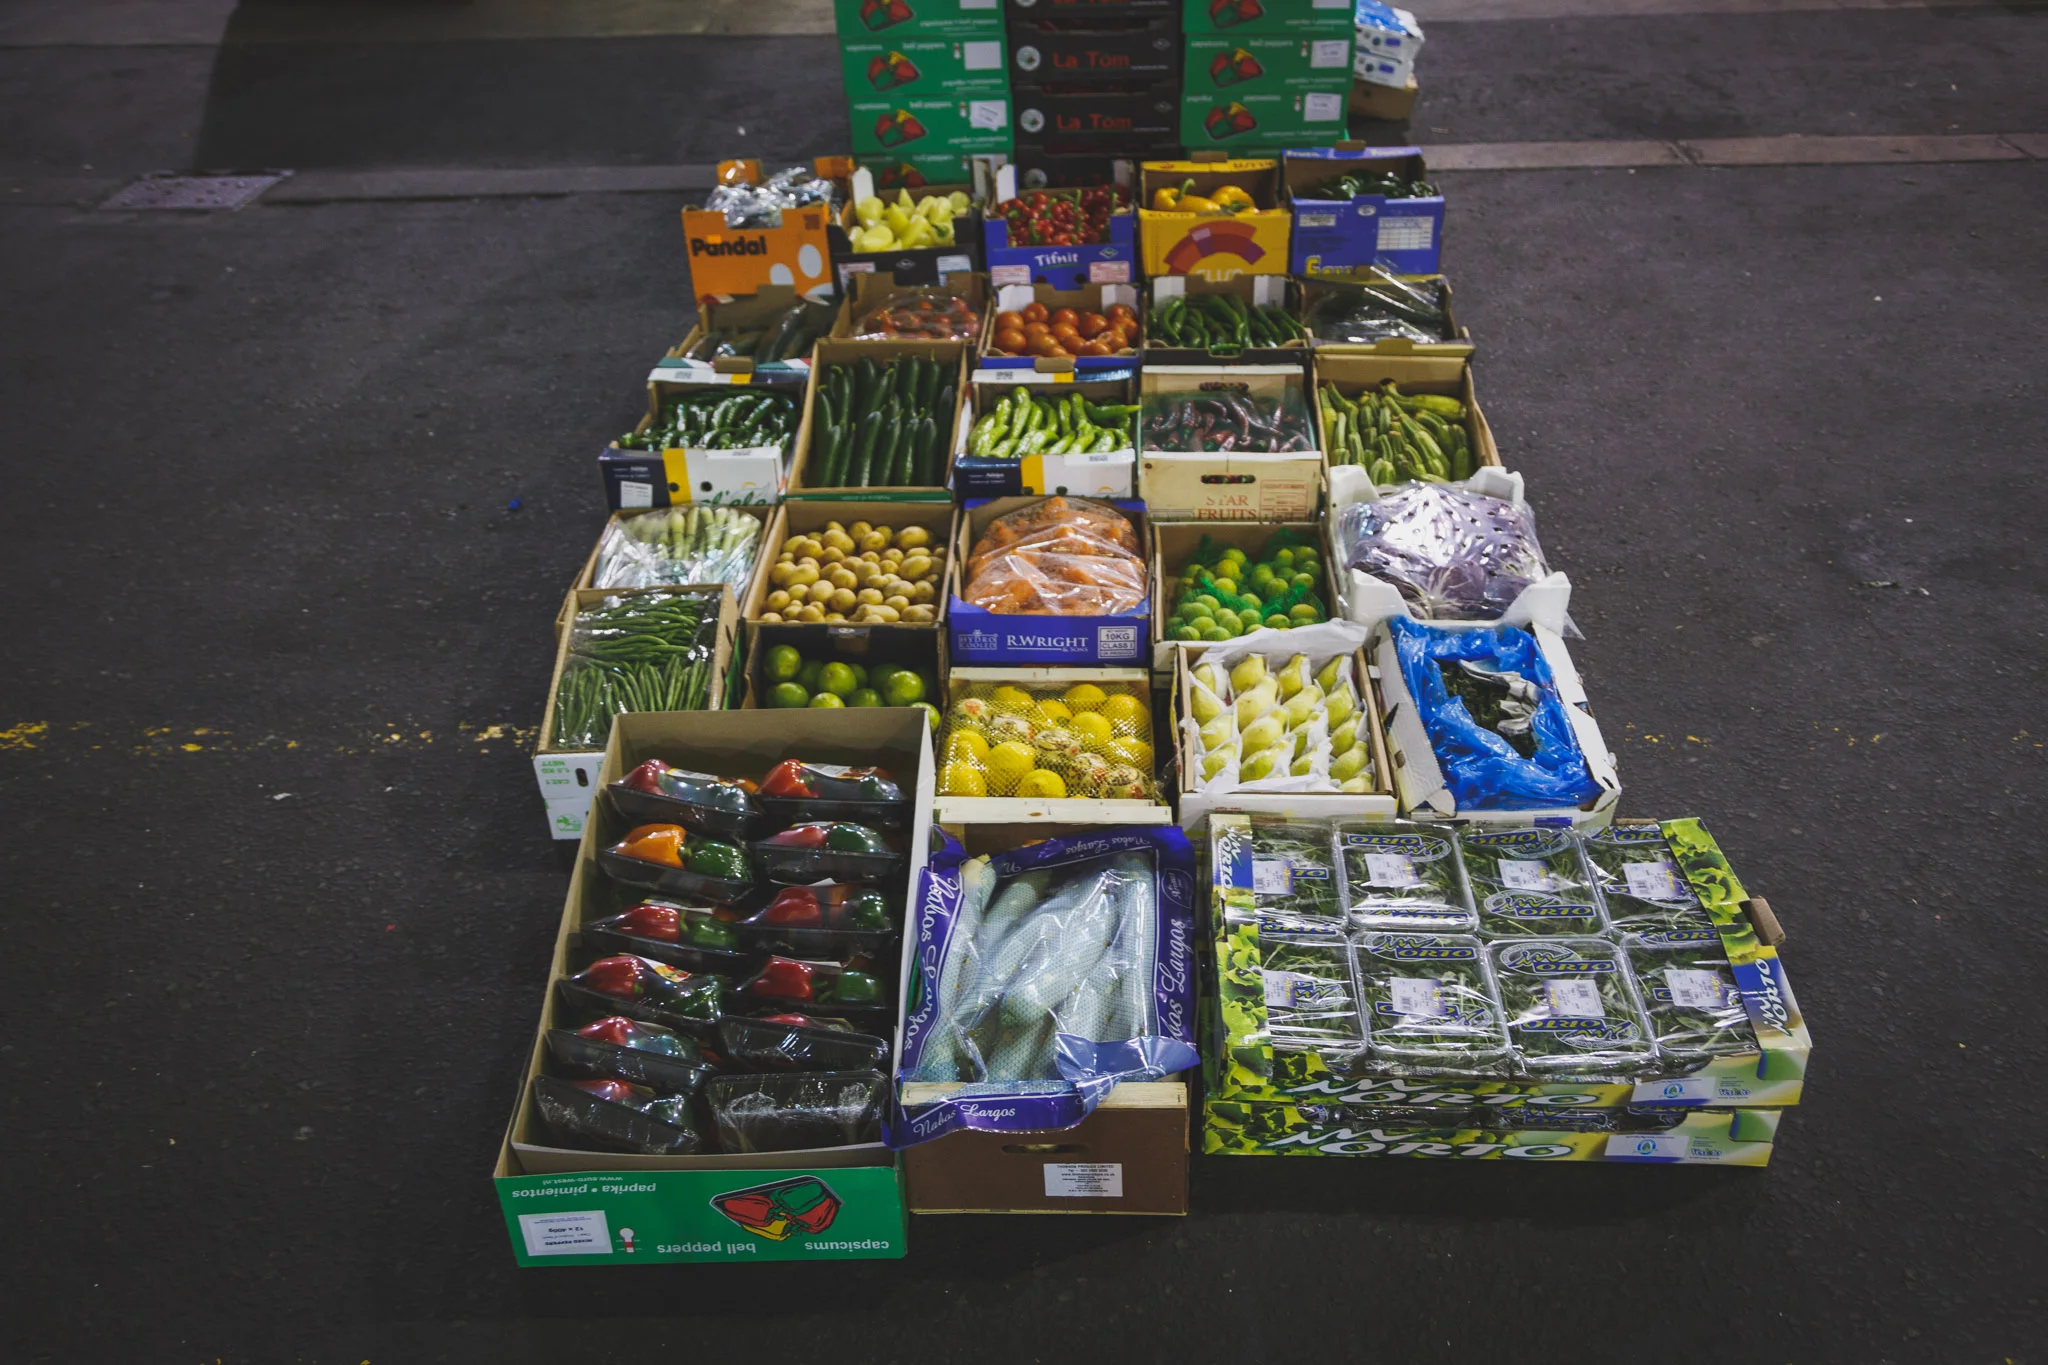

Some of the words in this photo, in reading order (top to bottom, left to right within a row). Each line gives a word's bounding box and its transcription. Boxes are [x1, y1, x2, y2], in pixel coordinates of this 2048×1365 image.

[1053, 52, 1078, 68] La
[1086, 51, 1130, 68] Tom
[1056, 114, 1081, 130] La
[1089, 113, 1131, 129] Tom
[691, 235, 767, 256] Pandal
[1197, 508, 1257, 520] FRUITS
[1007, 635, 1089, 647] R.WRIGHT
[1351, 836, 1418, 844] ORTO
[1221, 837, 1233, 890] ORTO
[1519, 907, 1591, 915] ORTO
[1158, 918, 1194, 994] Largos
[1398, 949, 1472, 957] ORTO
[1536, 962, 1612, 971] ORTO
[1755, 958, 1788, 1022] ORTO
[1160, 998, 1184, 1042] bos
[1522, 1020, 1600, 1028] ORTO
[1339, 1091, 1598, 1104] ORTO
[913, 1109, 956, 1137] Nabos
[960, 1104, 1016, 1121] Largos
[1319, 1141, 1573, 1157] ORTO
[543, 1177, 623, 1185] www.euro-west.nl
[512, 1184, 587, 1197] pimientos
[602, 1183, 656, 1194] paprika
[657, 1241, 722, 1253] peppers
[727, 1243, 756, 1254] bell
[805, 1239, 889, 1252] capsicums
